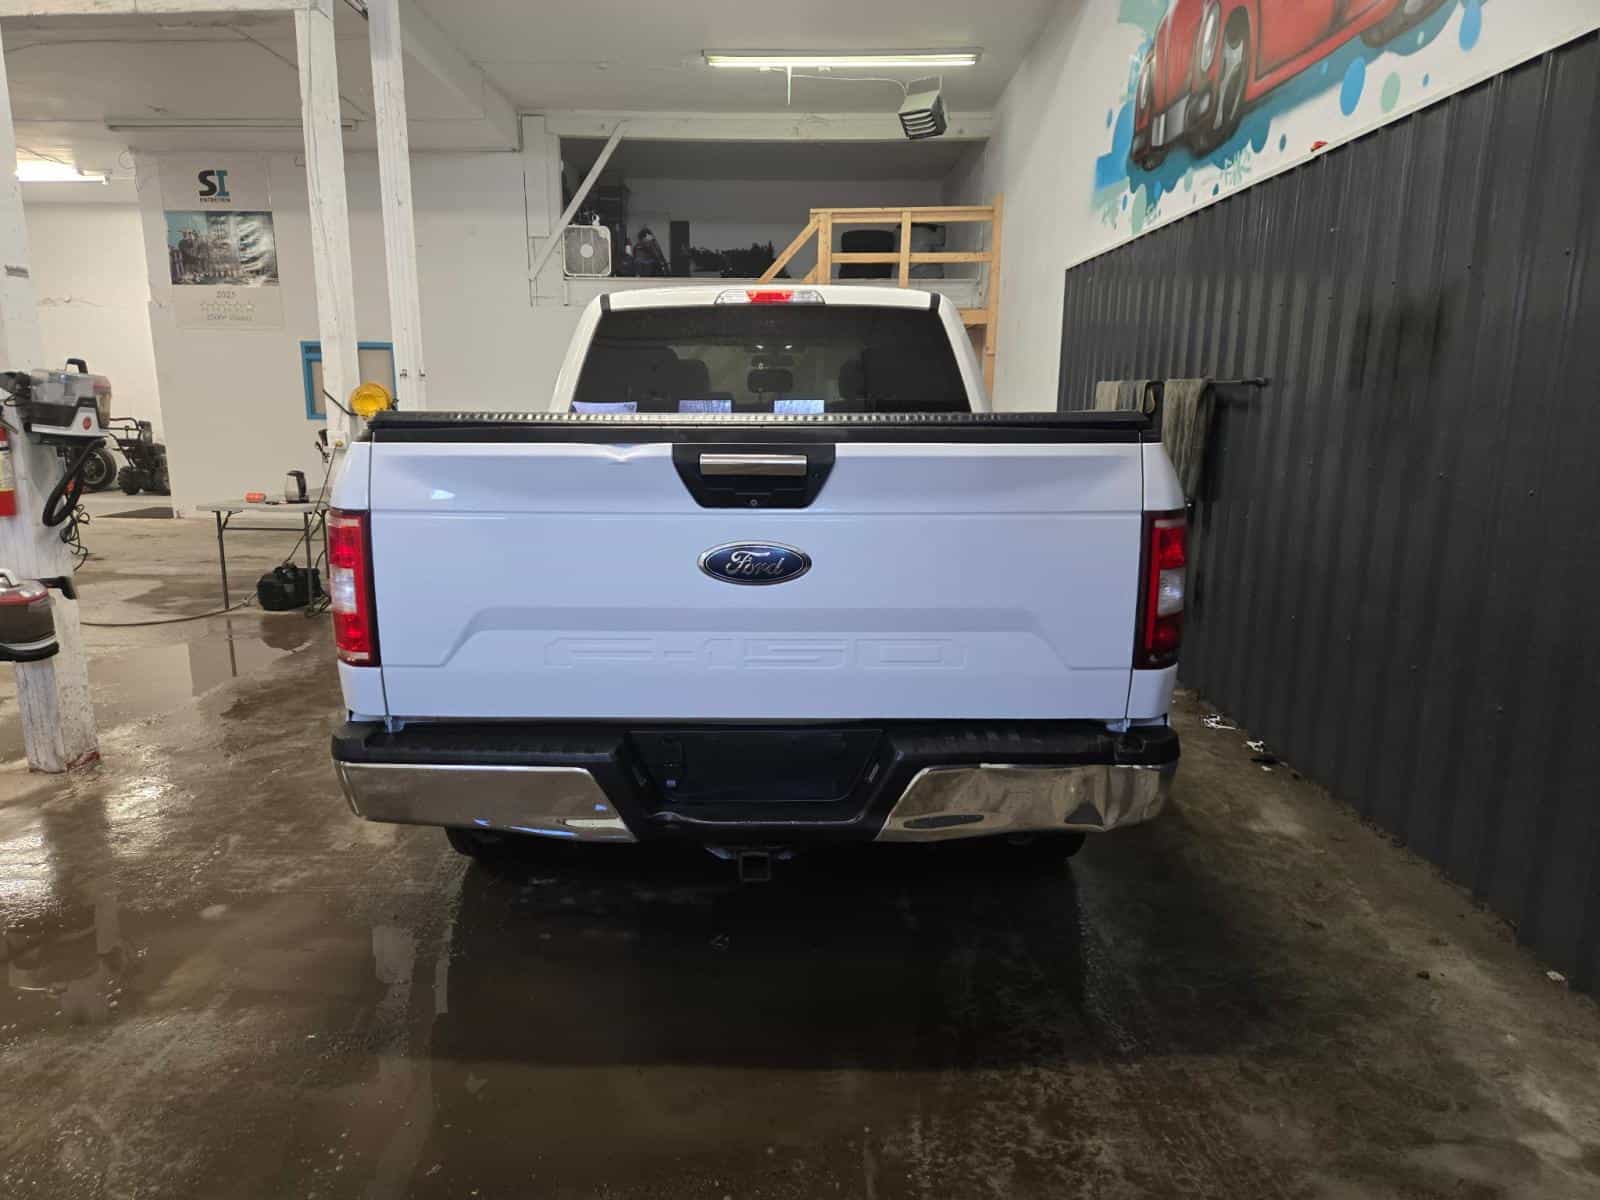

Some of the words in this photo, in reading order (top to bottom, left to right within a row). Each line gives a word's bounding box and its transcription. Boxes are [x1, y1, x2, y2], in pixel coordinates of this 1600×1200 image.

[198, 169, 229, 196] SI
[725, 550, 785, 575] Ford
[543, 636, 968, 670] F-150
